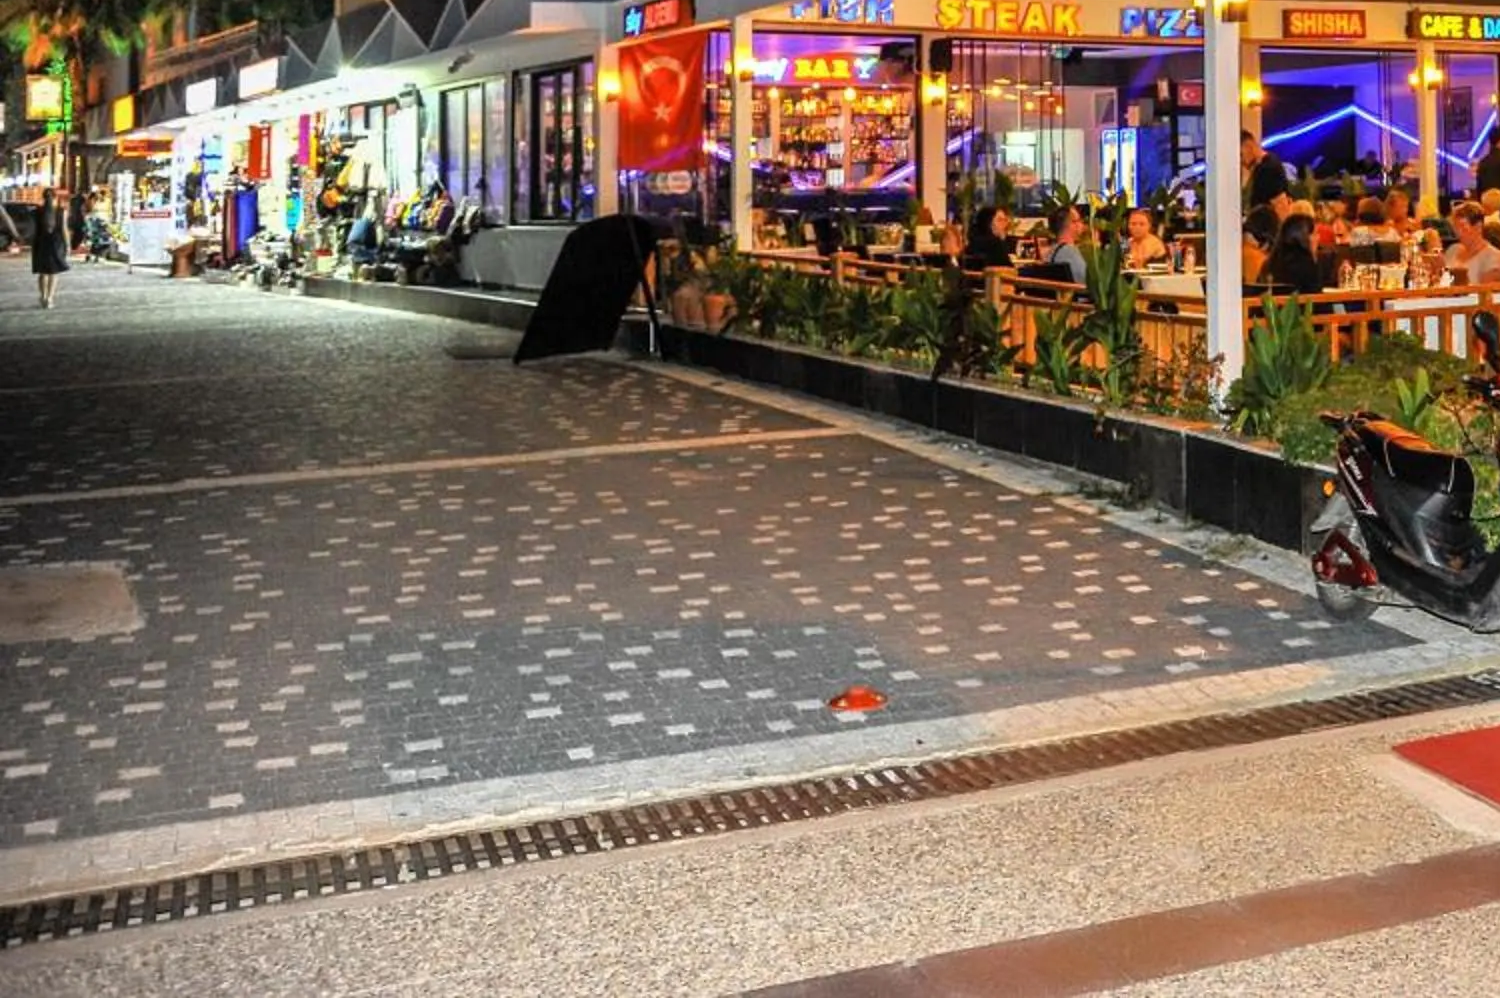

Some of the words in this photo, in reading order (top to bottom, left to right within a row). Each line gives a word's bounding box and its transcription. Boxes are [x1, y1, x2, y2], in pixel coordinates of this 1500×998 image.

[1120, 7, 1204, 38] PIZZ
[1289, 11, 1363, 36] SHISHA
[1420, 15, 1463, 39] CAFE
[1467, 17, 1483, 39] &
